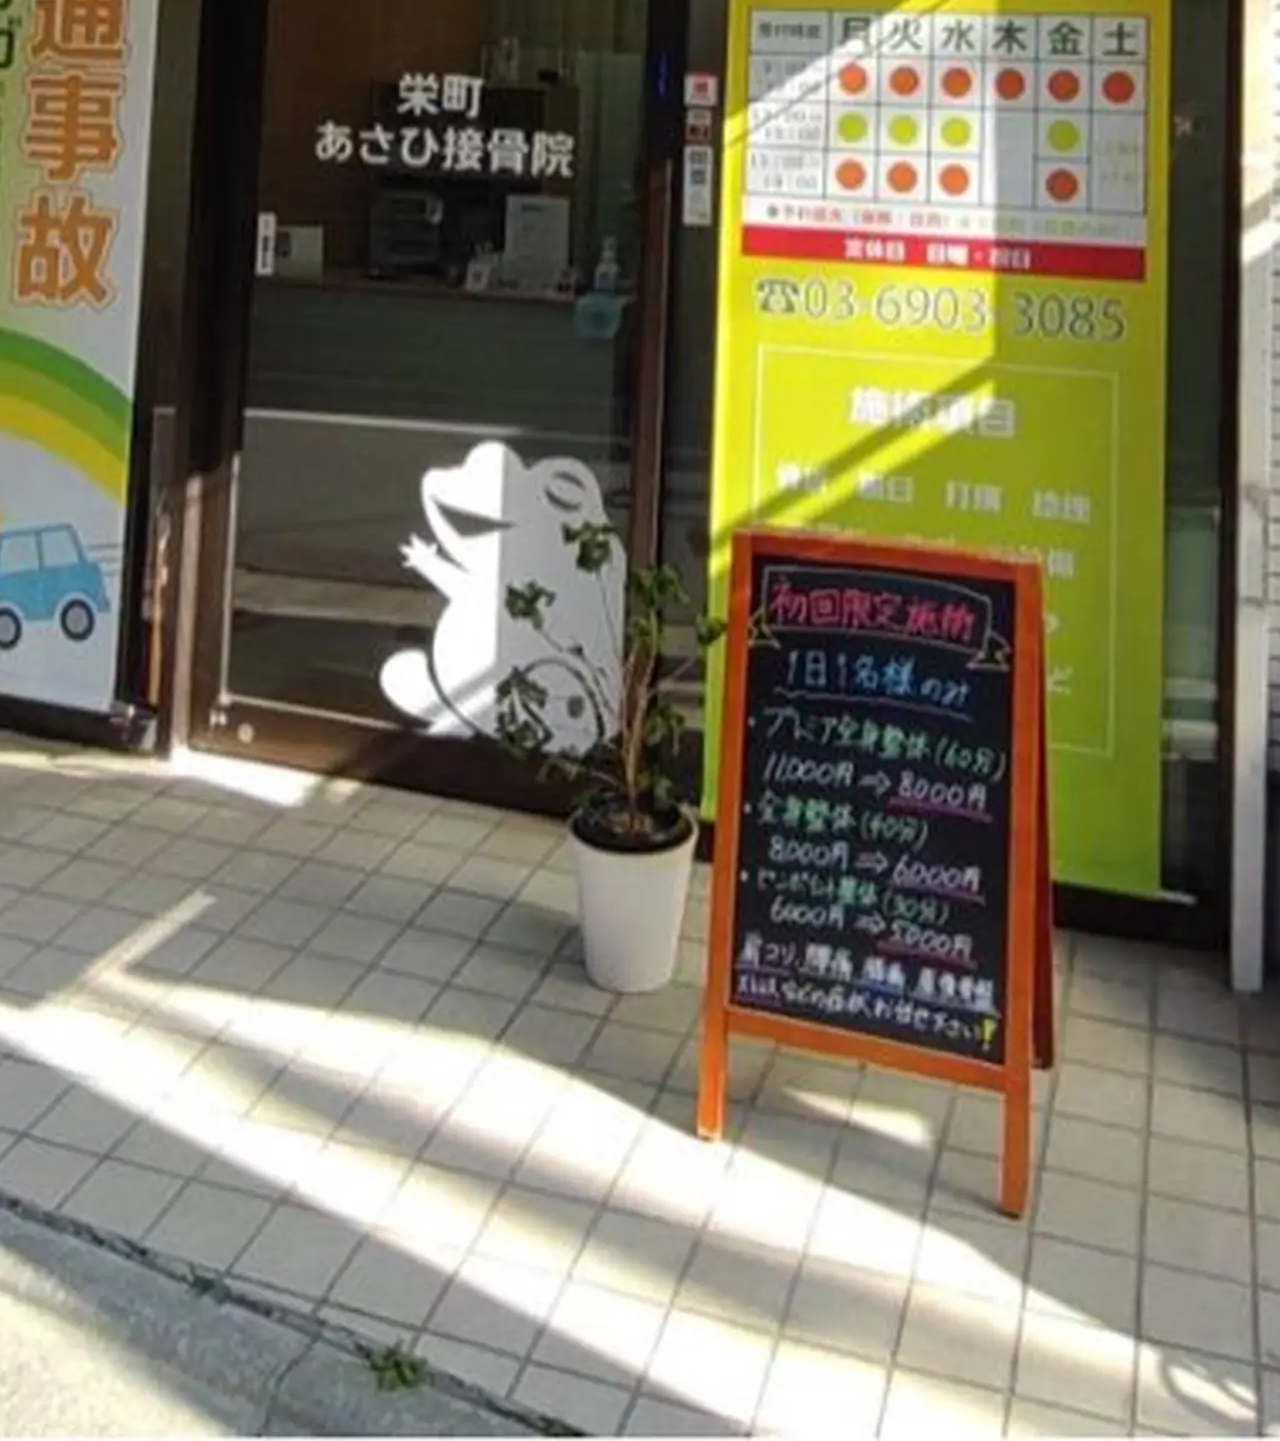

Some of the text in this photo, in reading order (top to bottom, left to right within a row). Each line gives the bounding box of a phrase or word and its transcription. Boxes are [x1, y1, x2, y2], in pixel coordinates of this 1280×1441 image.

[890, 17, 923, 51] 火
[940, 19, 976, 53] 水
[991, 19, 1028, 55] 木
[1046, 20, 1085, 57] 金
[1101, 21, 1139, 57] 土
[398, 73, 483, 118] 栄町
[316, 122, 574, 177] あさひ接骨院
[772, 580, 975, 643] 初回限定施術
